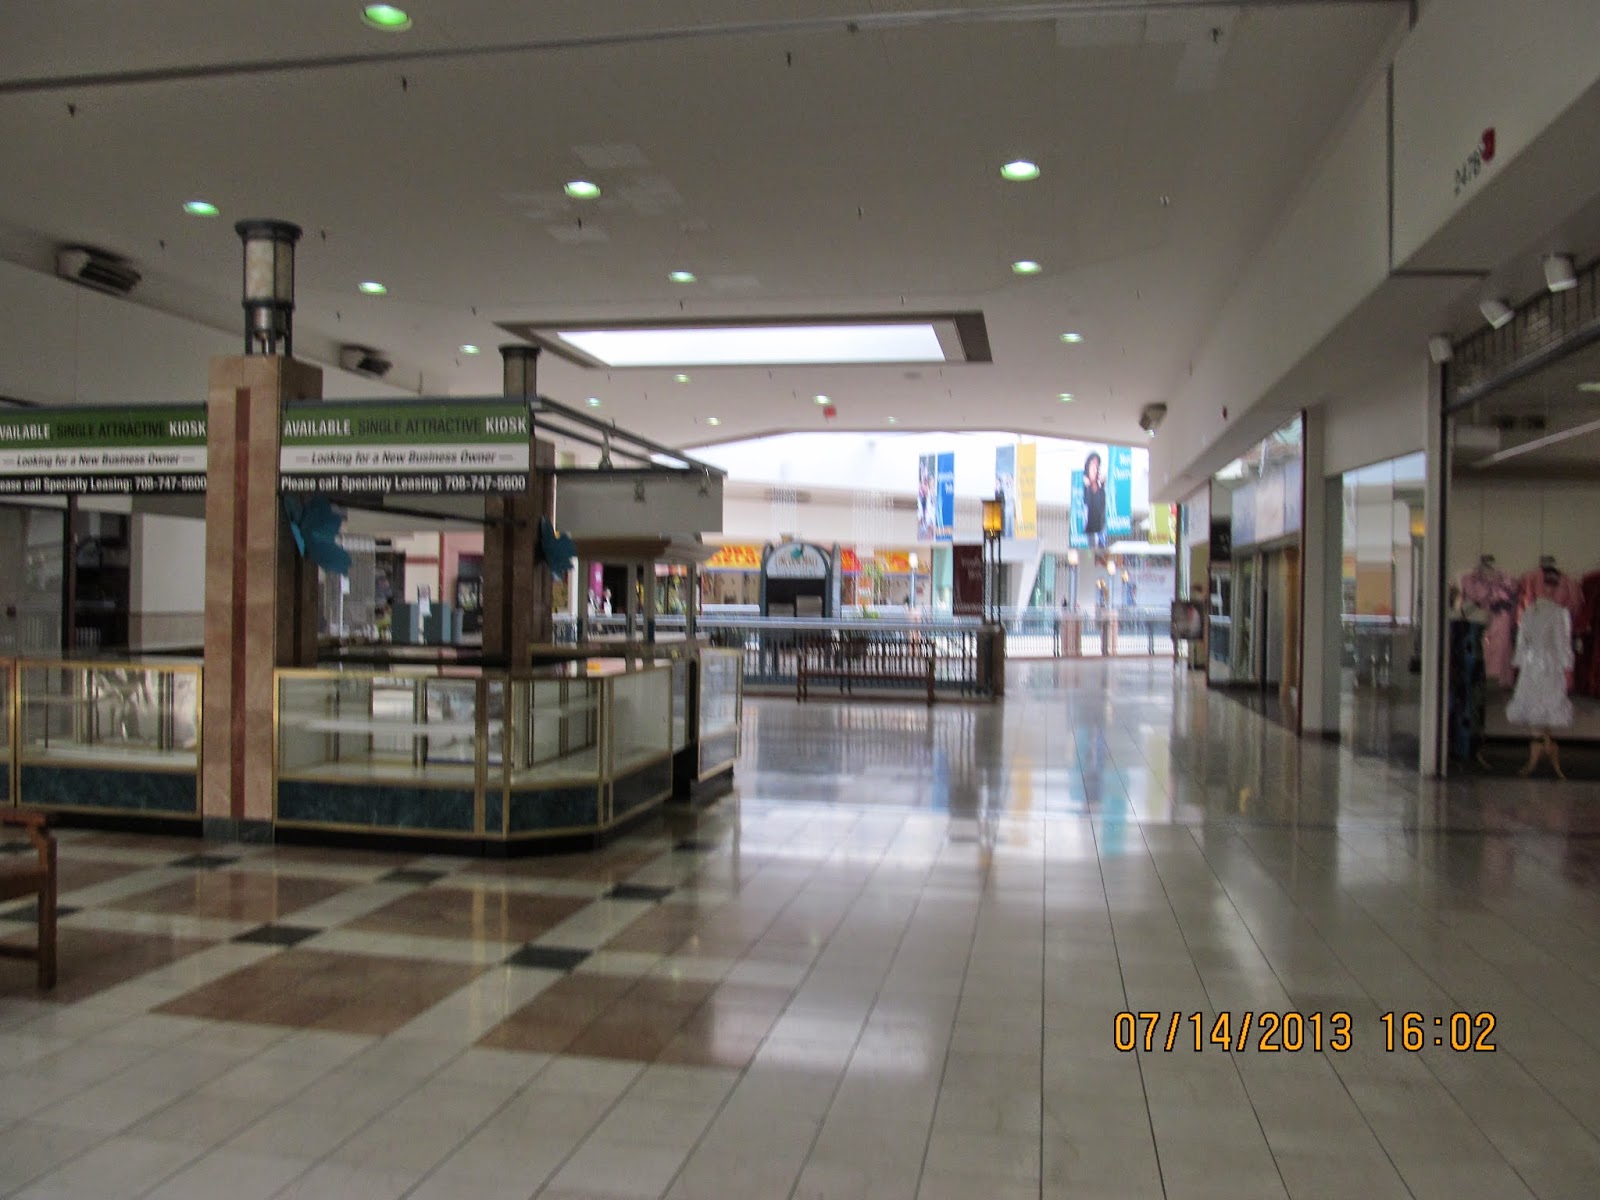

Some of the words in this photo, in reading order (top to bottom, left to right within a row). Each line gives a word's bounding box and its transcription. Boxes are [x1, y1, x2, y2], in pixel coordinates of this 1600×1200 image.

[56, 421, 95, 440] SINGLE
[99, 420, 166, 439] ATTRACTIVE
[169, 419, 206, 437] KIOSK
[358, 418, 401, 436] SINGLE
[405, 416, 480, 435] ATTRACTIVE
[485, 415, 527, 434] KIOSK
[16, 454, 53, 468] Looking
[55, 453, 68, 467] for
[79, 452, 99, 466] New
[102, 452, 146, 466] Business
[148, 451, 180, 466] Owner
[311, 450, 352, 467] Looking
[355, 451, 370, 465] for
[382, 449, 405, 465] New
[408, 449, 457, 464] Business
[460, 448, 496, 464] Owner
[23, 477, 41, 491] call
[43, 476, 88, 494] Specialty
[90, 475, 132, 494] Leasing:
[281, 475, 316, 491] Please
[318, 475, 338, 491] call
[341, 474, 391, 493] Specialty
[394, 474, 442, 494] Leasing:
